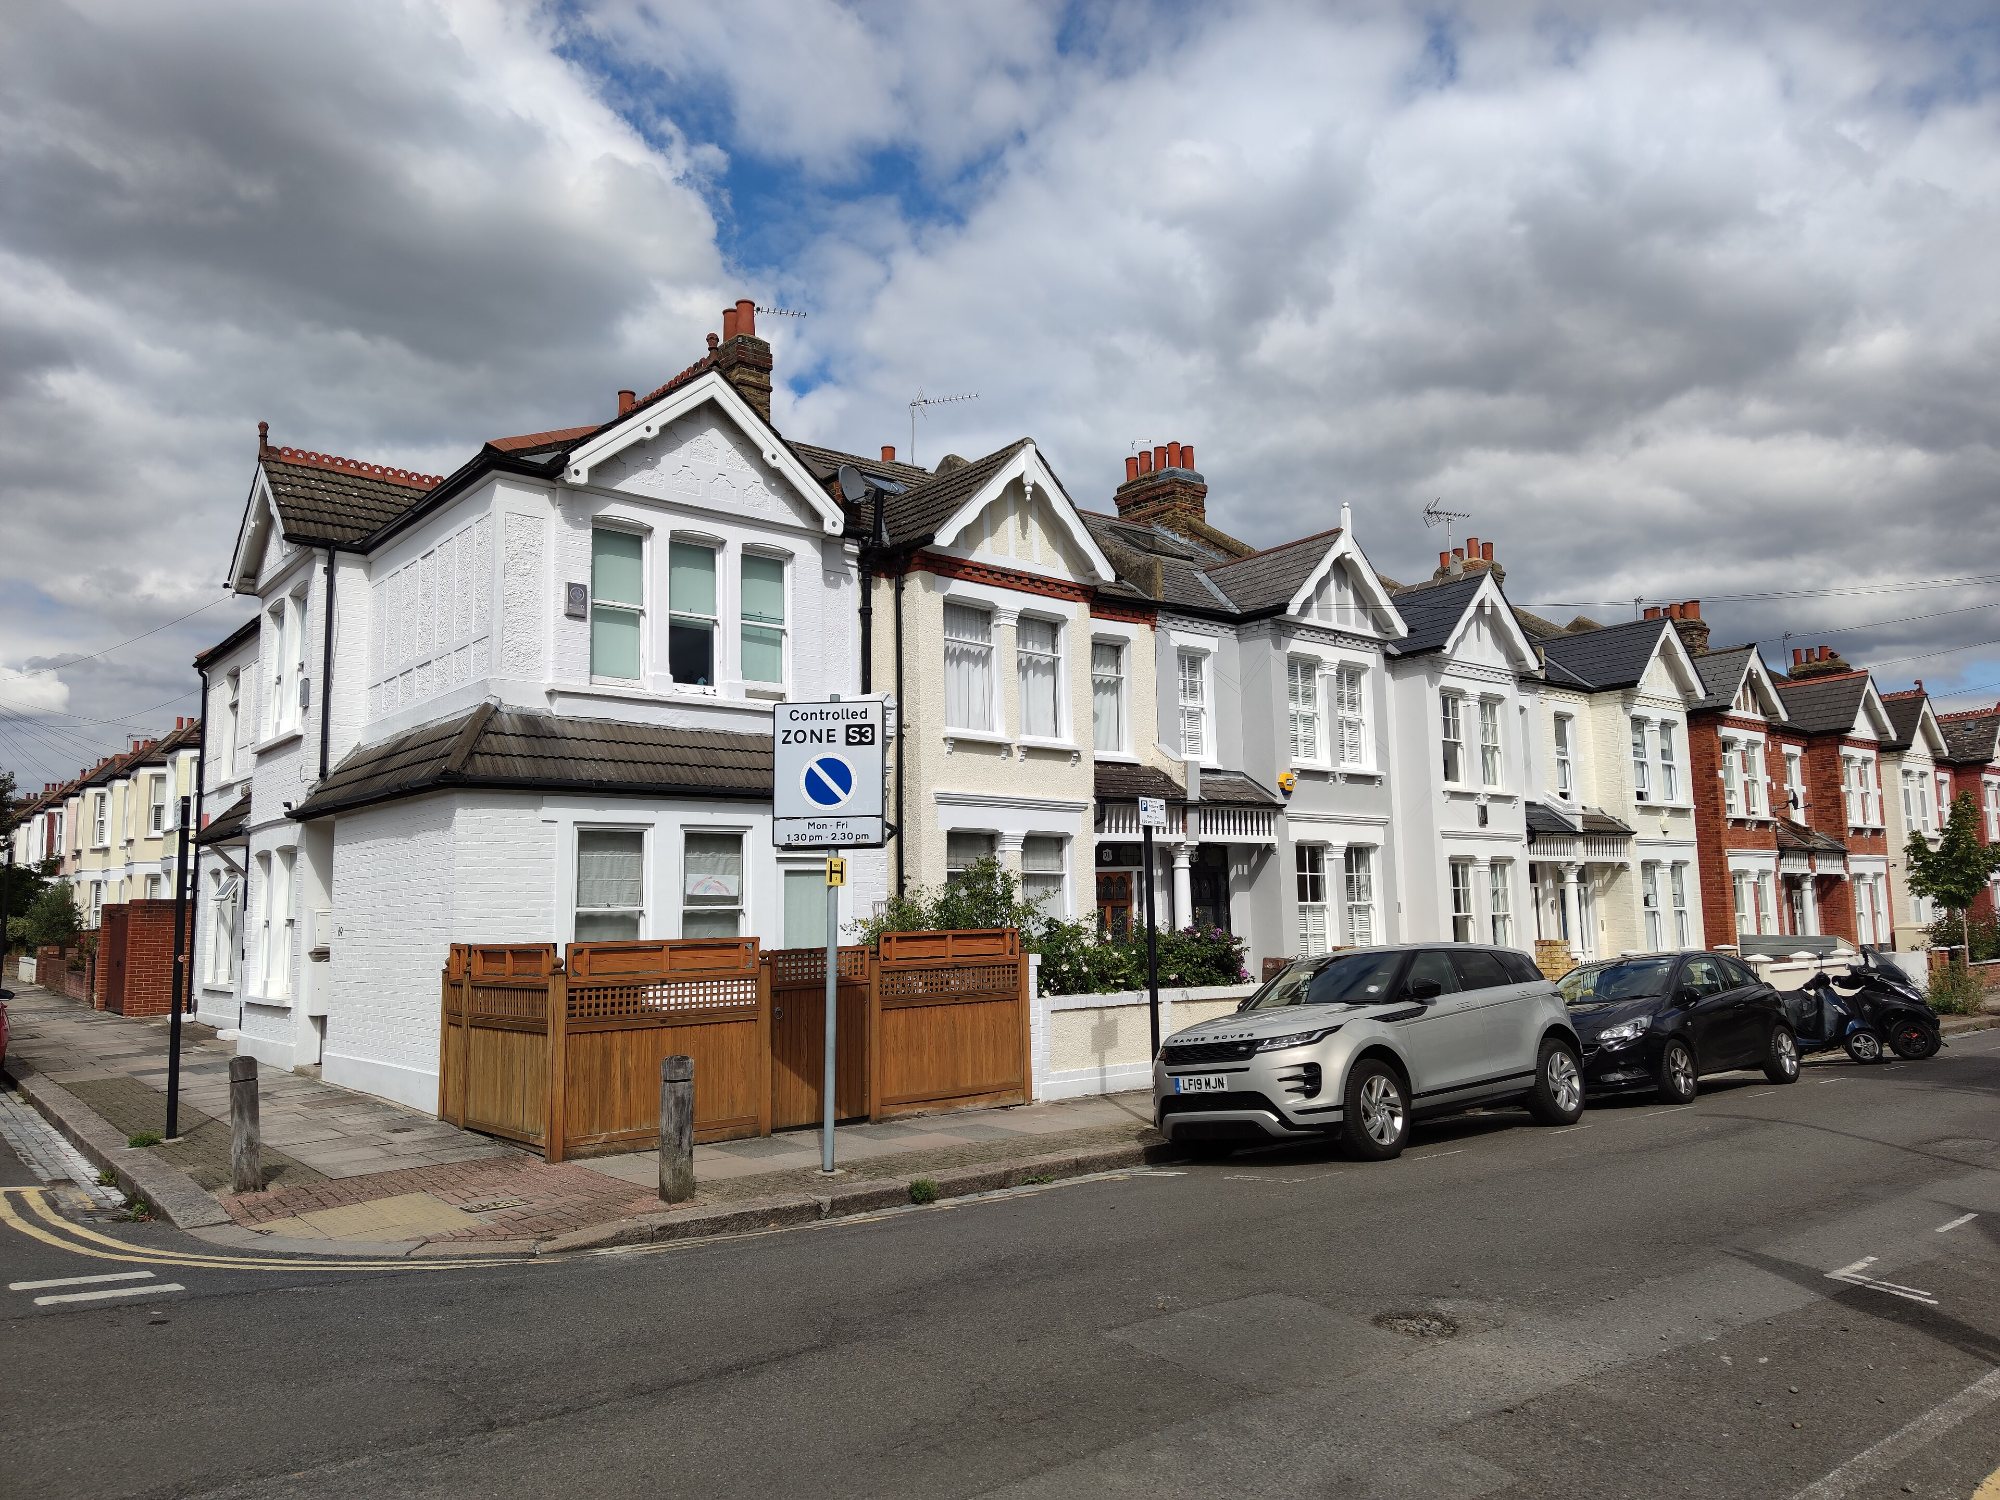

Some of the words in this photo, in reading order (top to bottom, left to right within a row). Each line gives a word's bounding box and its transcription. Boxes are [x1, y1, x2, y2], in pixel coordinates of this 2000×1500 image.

[789, 708, 868, 721] Controlled
[781, 728, 837, 744] ZONE
[847, 727, 873, 743] S3
[807, 821, 828, 830] Mon
[836, 821, 848, 830] Fri
[786, 833, 807, 842] 1.30
[808, 834, 823, 843] pm
[830, 832, 854, 841] 2.30
[855, 833, 870, 842] pm
[1213, 1032, 1255, 1040] ROVER
[1182, 1078, 1203, 1091] LF19
[1204, 1077, 1225, 1089] MJN
